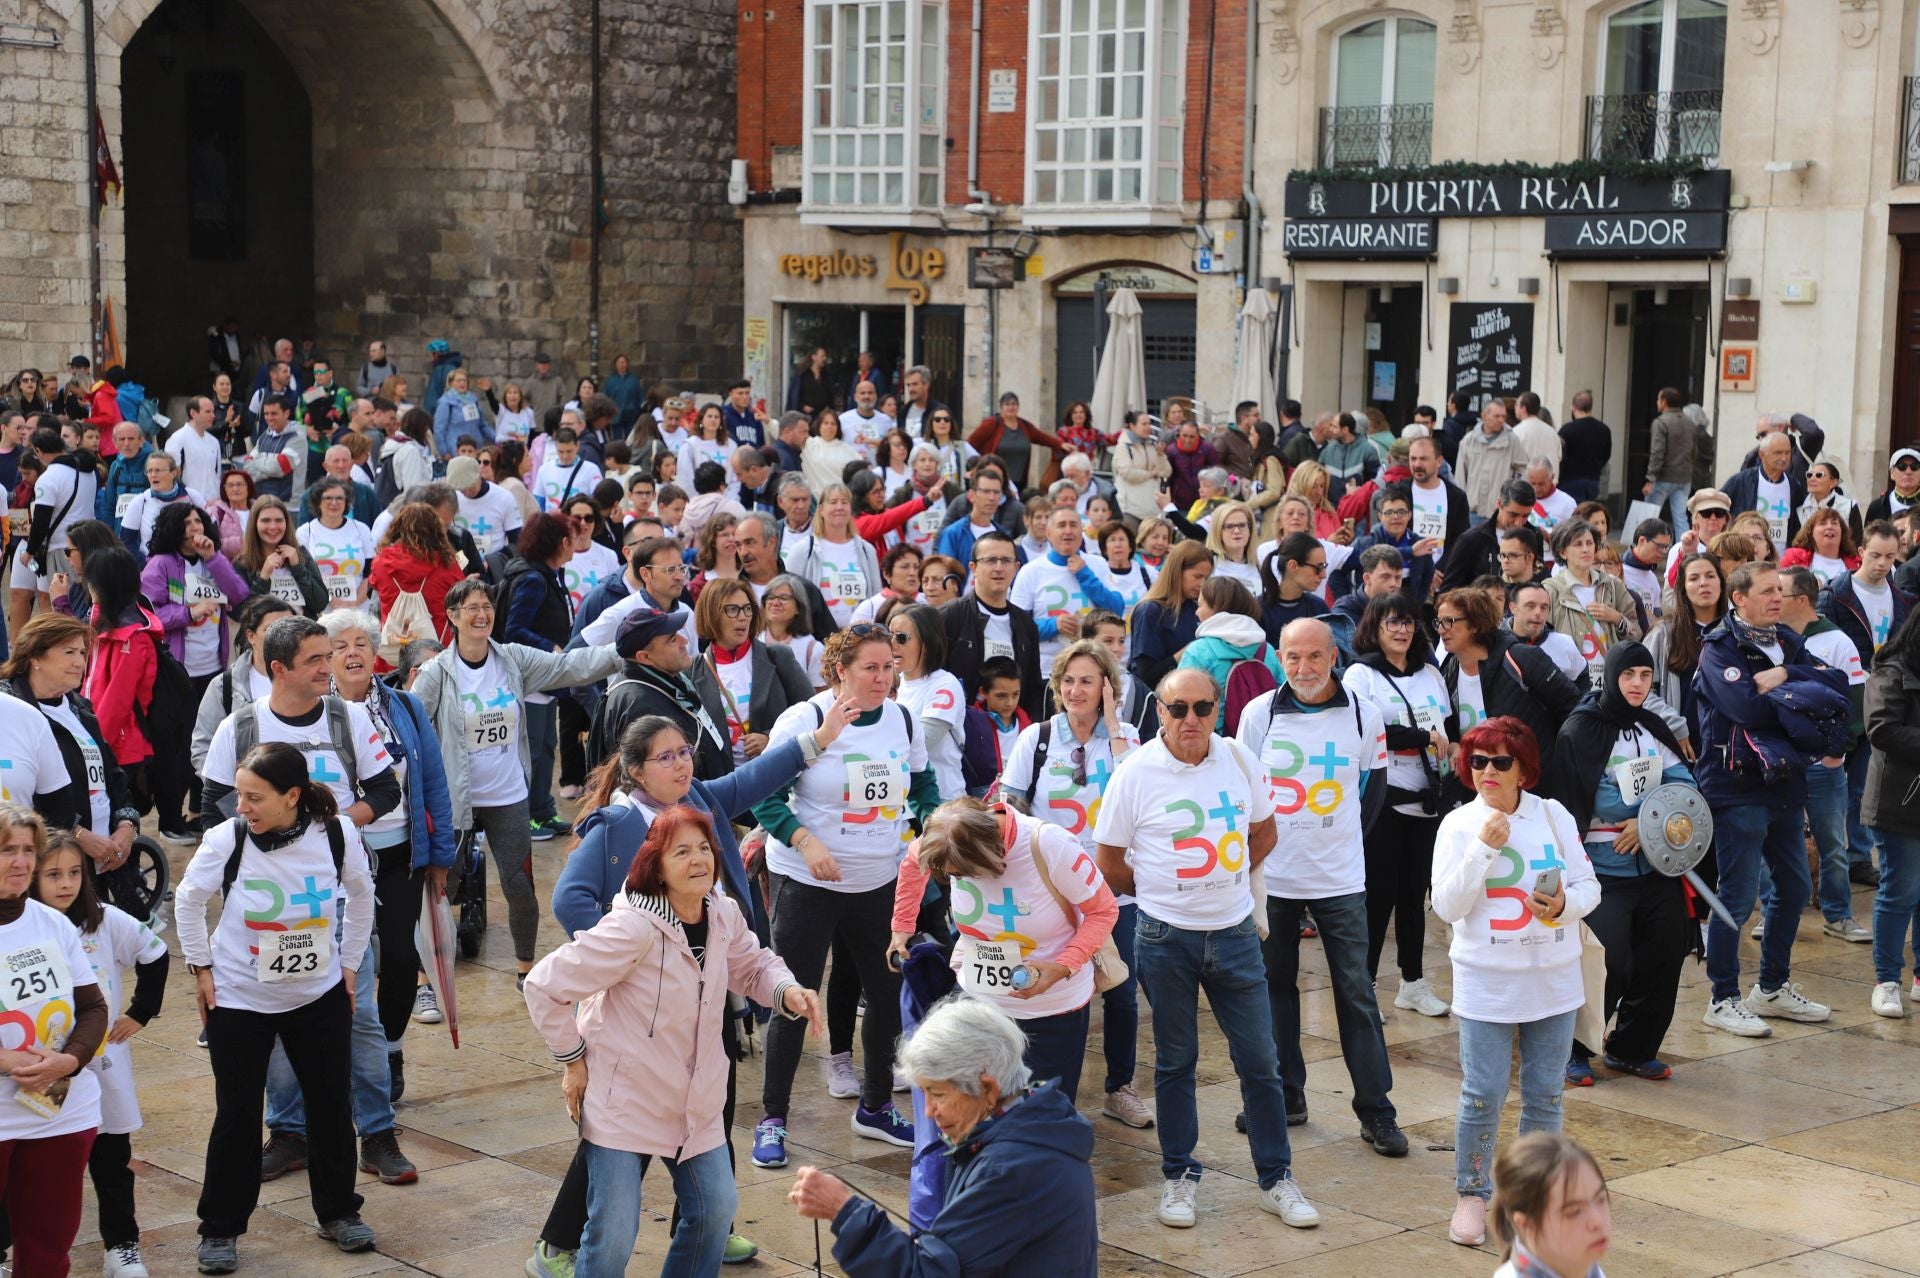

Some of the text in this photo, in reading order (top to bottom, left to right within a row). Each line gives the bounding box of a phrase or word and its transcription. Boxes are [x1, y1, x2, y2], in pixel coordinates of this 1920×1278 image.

[1370, 175, 1619, 214] PUERTA REAL
[1285, 223, 1429, 248] RESTAURANTE
[1576, 218, 1687, 245] ASADOR
[779, 248, 878, 283] regalos
[1420, 523, 1442, 535] 277
[271, 589, 300, 602] 723
[837, 584, 861, 596] 195
[474, 725, 508, 744] 750
[862, 763, 888, 772] Semana
[865, 782, 888, 801] 63
[1633, 776, 1646, 796] 92
[279, 933, 312, 943] Semana
[6, 948, 42, 965] Semana
[976, 943, 1003, 954] Semana
[269, 953, 318, 973] 423
[11, 967, 59, 1001] 251
[974, 963, 1012, 987] 759
